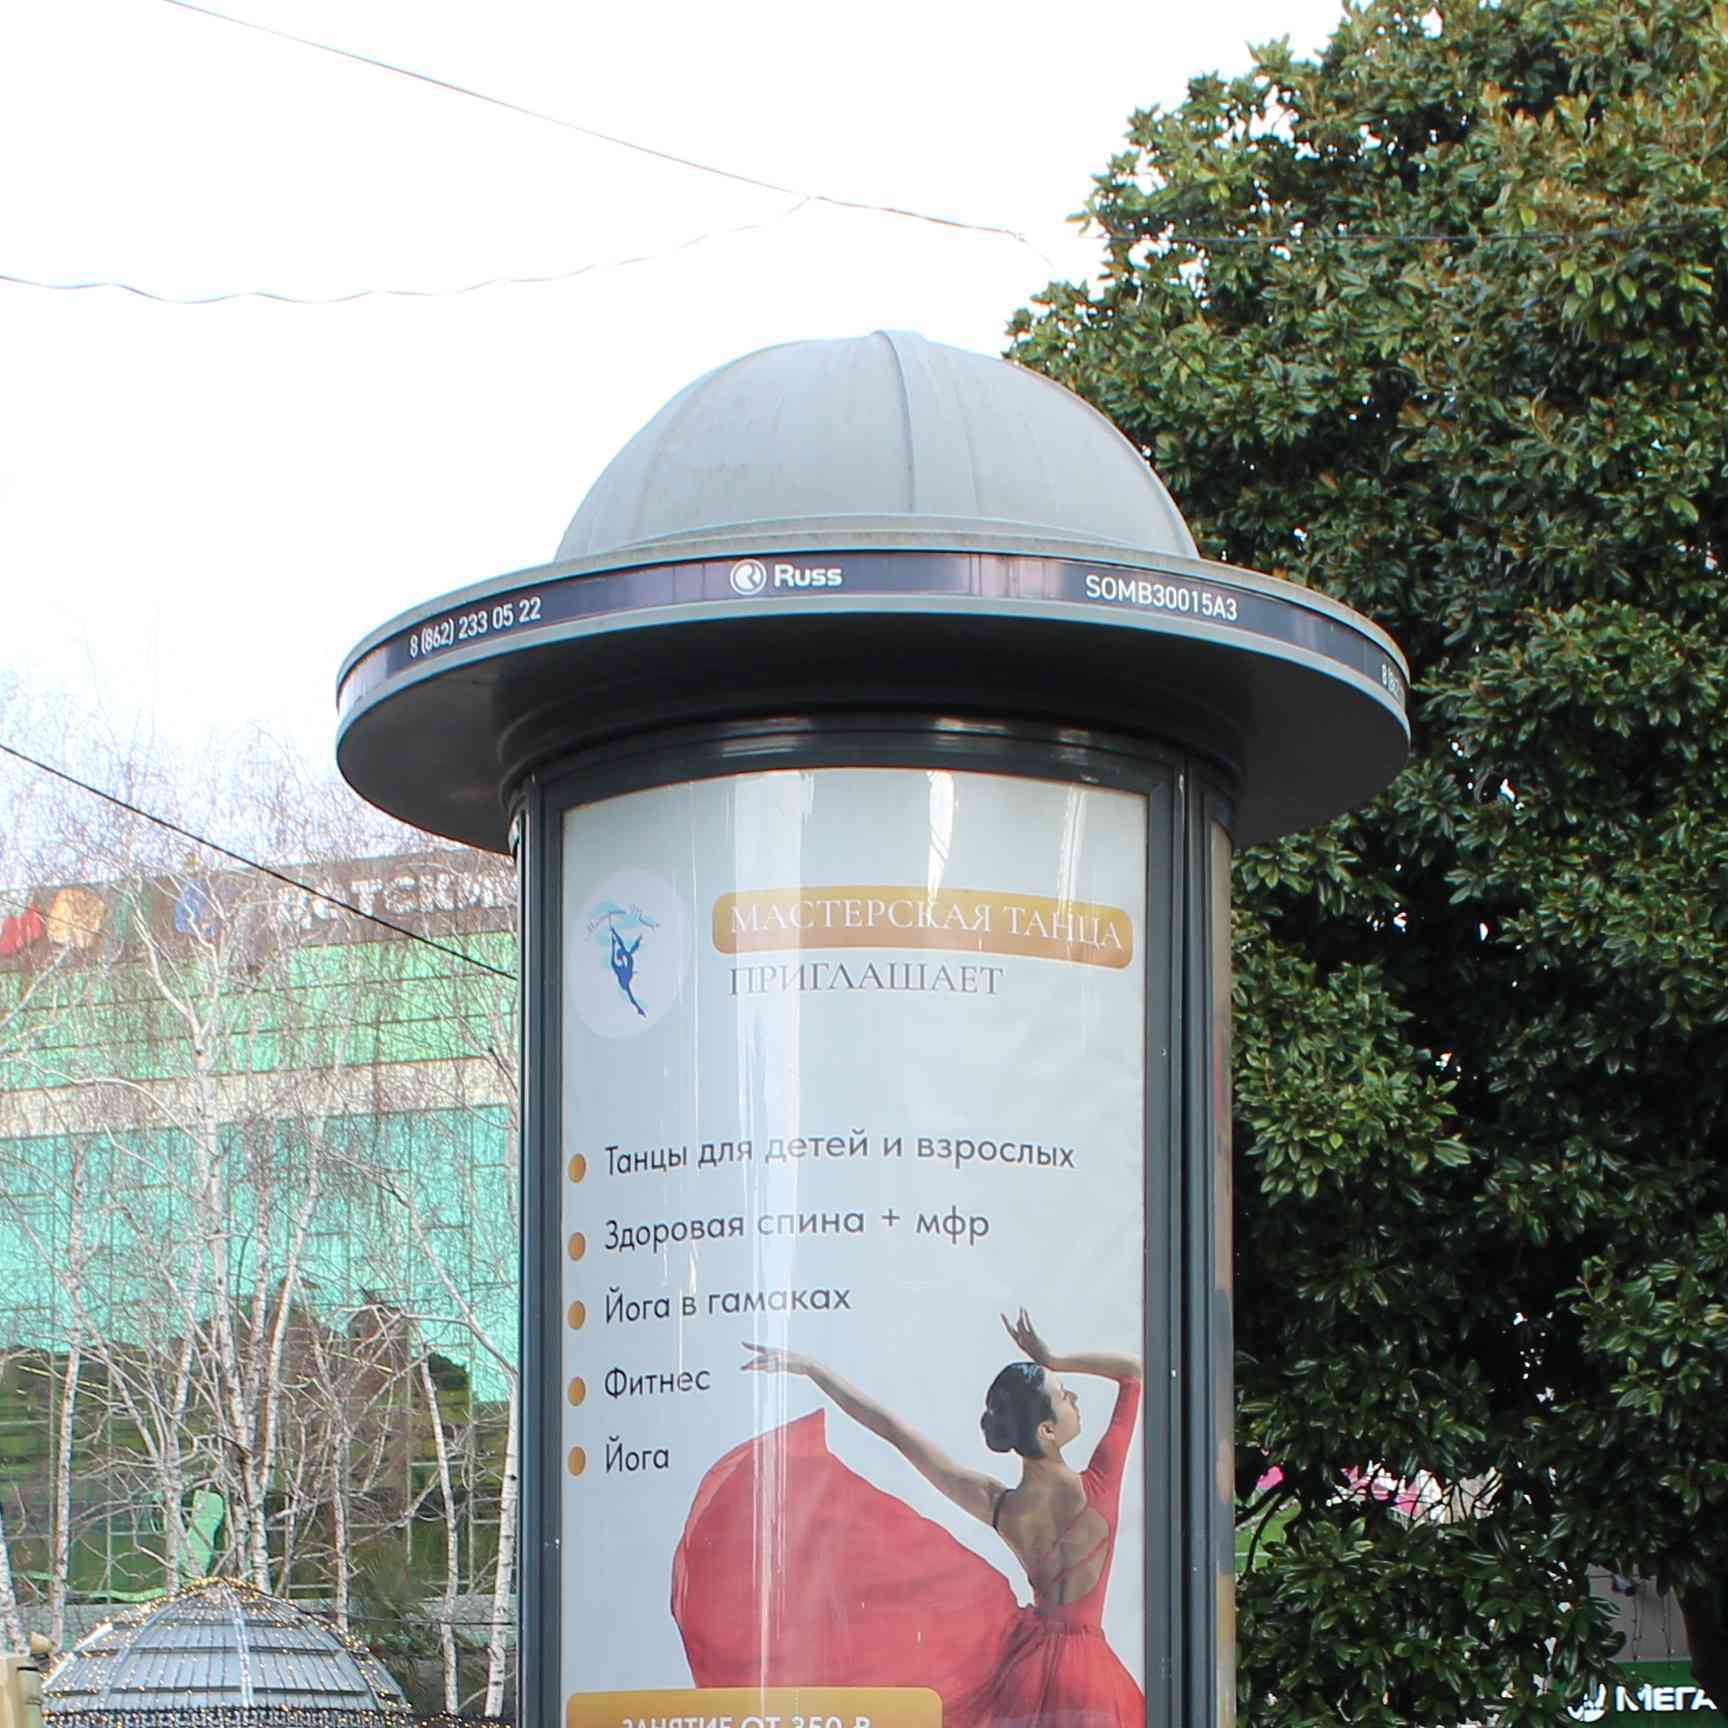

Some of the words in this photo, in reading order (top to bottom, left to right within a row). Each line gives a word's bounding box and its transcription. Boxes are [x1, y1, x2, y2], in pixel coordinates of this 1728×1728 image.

[774, 563, 843, 588] Russ
[1085, 573, 1239, 622] SOMB30015A3
[409, 634, 419, 658] 8
[421, 618, 454, 655] (862)
[458, 610, 488, 641] 233
[492, 603, 514, 630] 05
[519, 596, 542, 623] 22
[729, 898, 993, 935] МАСТЕРСКАЯ
[1003, 905, 1124, 951] ТАНЦА
[728, 961, 1005, 997] ПРИГЛАШАЕТ
[605, 1144, 688, 1177] Танцы
[698, 1141, 753, 1169] для
[765, 1128, 870, 1163] детей
[883, 1136, 903, 1158] и
[917, 1136, 1076, 1170] взрослых
[604, 1217, 745, 1254] Здоровая
[756, 1209, 865, 1238] спина
[881, 1208, 901, 1228] +
[915, 1205, 991, 1246] мфр
[605, 1286, 670, 1324] Йога
[681, 1296, 698, 1317] в
[708, 1287, 852, 1315] гамаках
[604, 1366, 712, 1400] Фитнес
[605, 1435, 670, 1474] Йога
[1615, 1683, 1718, 1712] МЕГА
